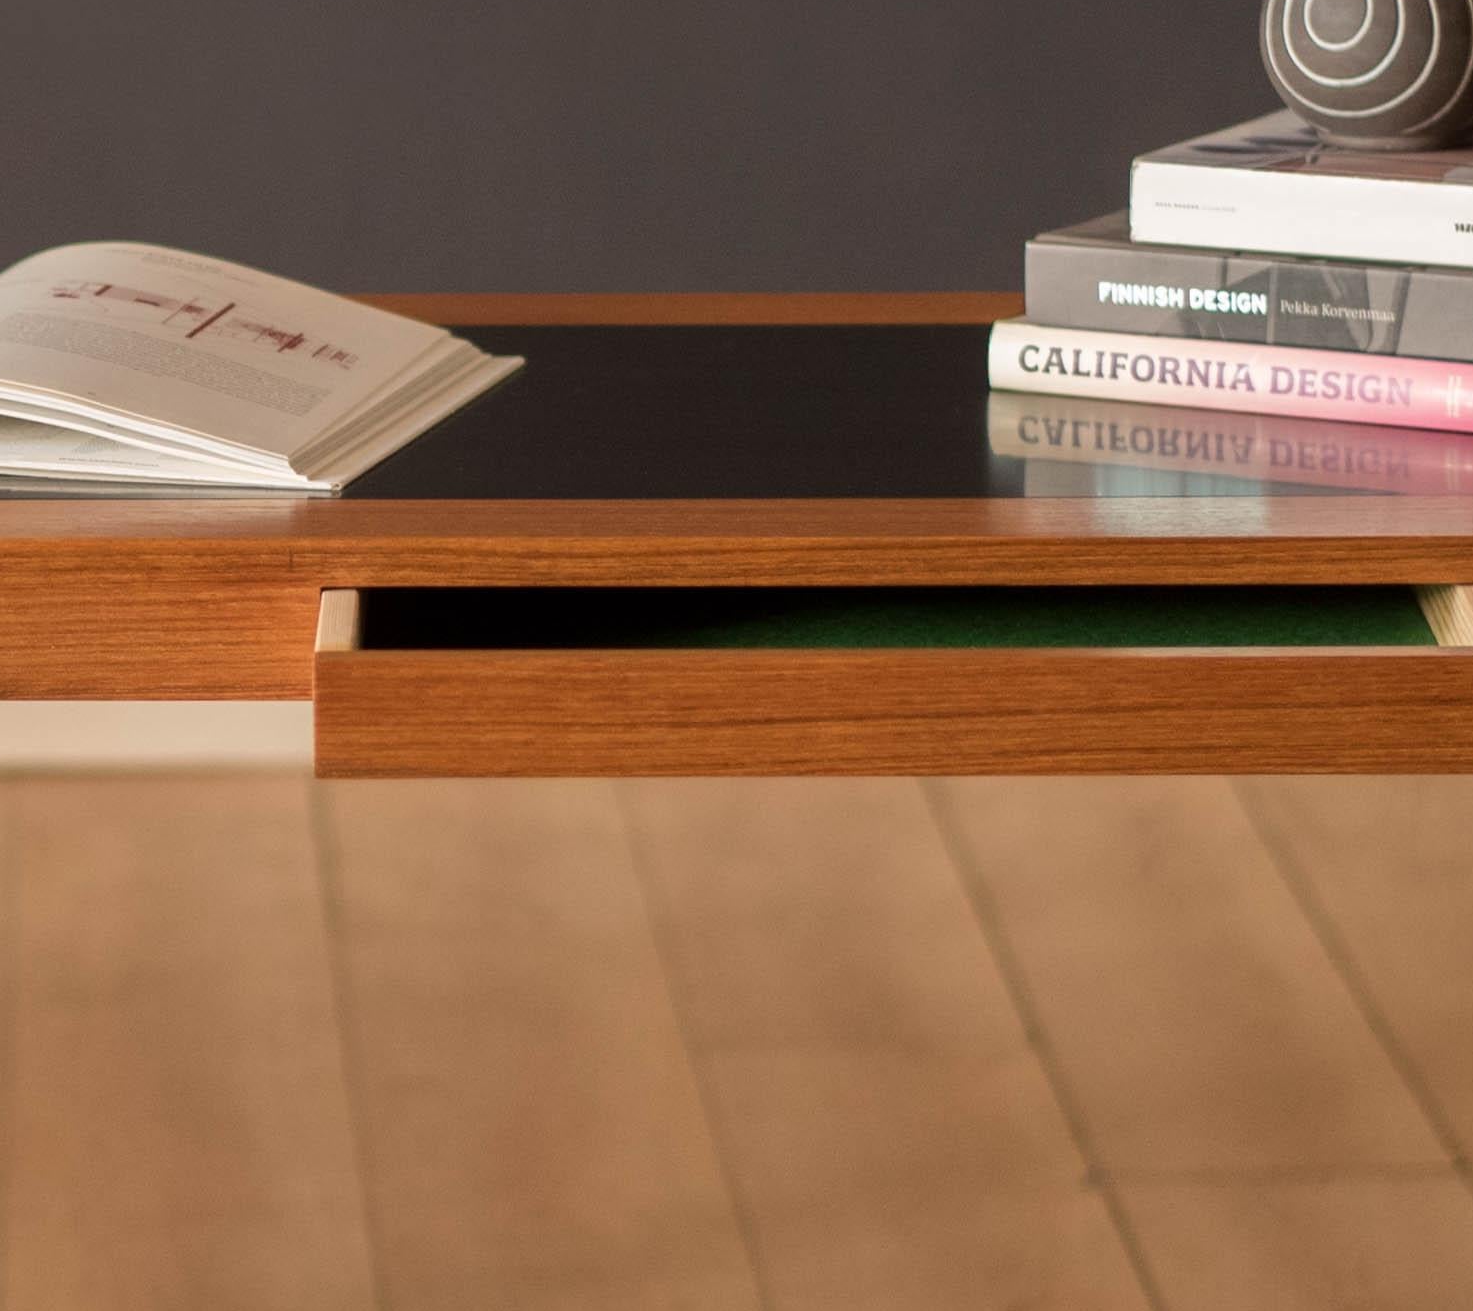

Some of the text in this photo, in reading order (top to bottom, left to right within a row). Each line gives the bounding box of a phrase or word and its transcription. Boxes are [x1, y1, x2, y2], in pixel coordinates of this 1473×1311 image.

[1098, 281, 1396, 323] FINNISH DESIGN Pekka Korvenmaa
[1018, 344, 1255, 392] CALIFORNIA
[1269, 366, 1414, 406] DESIGN
